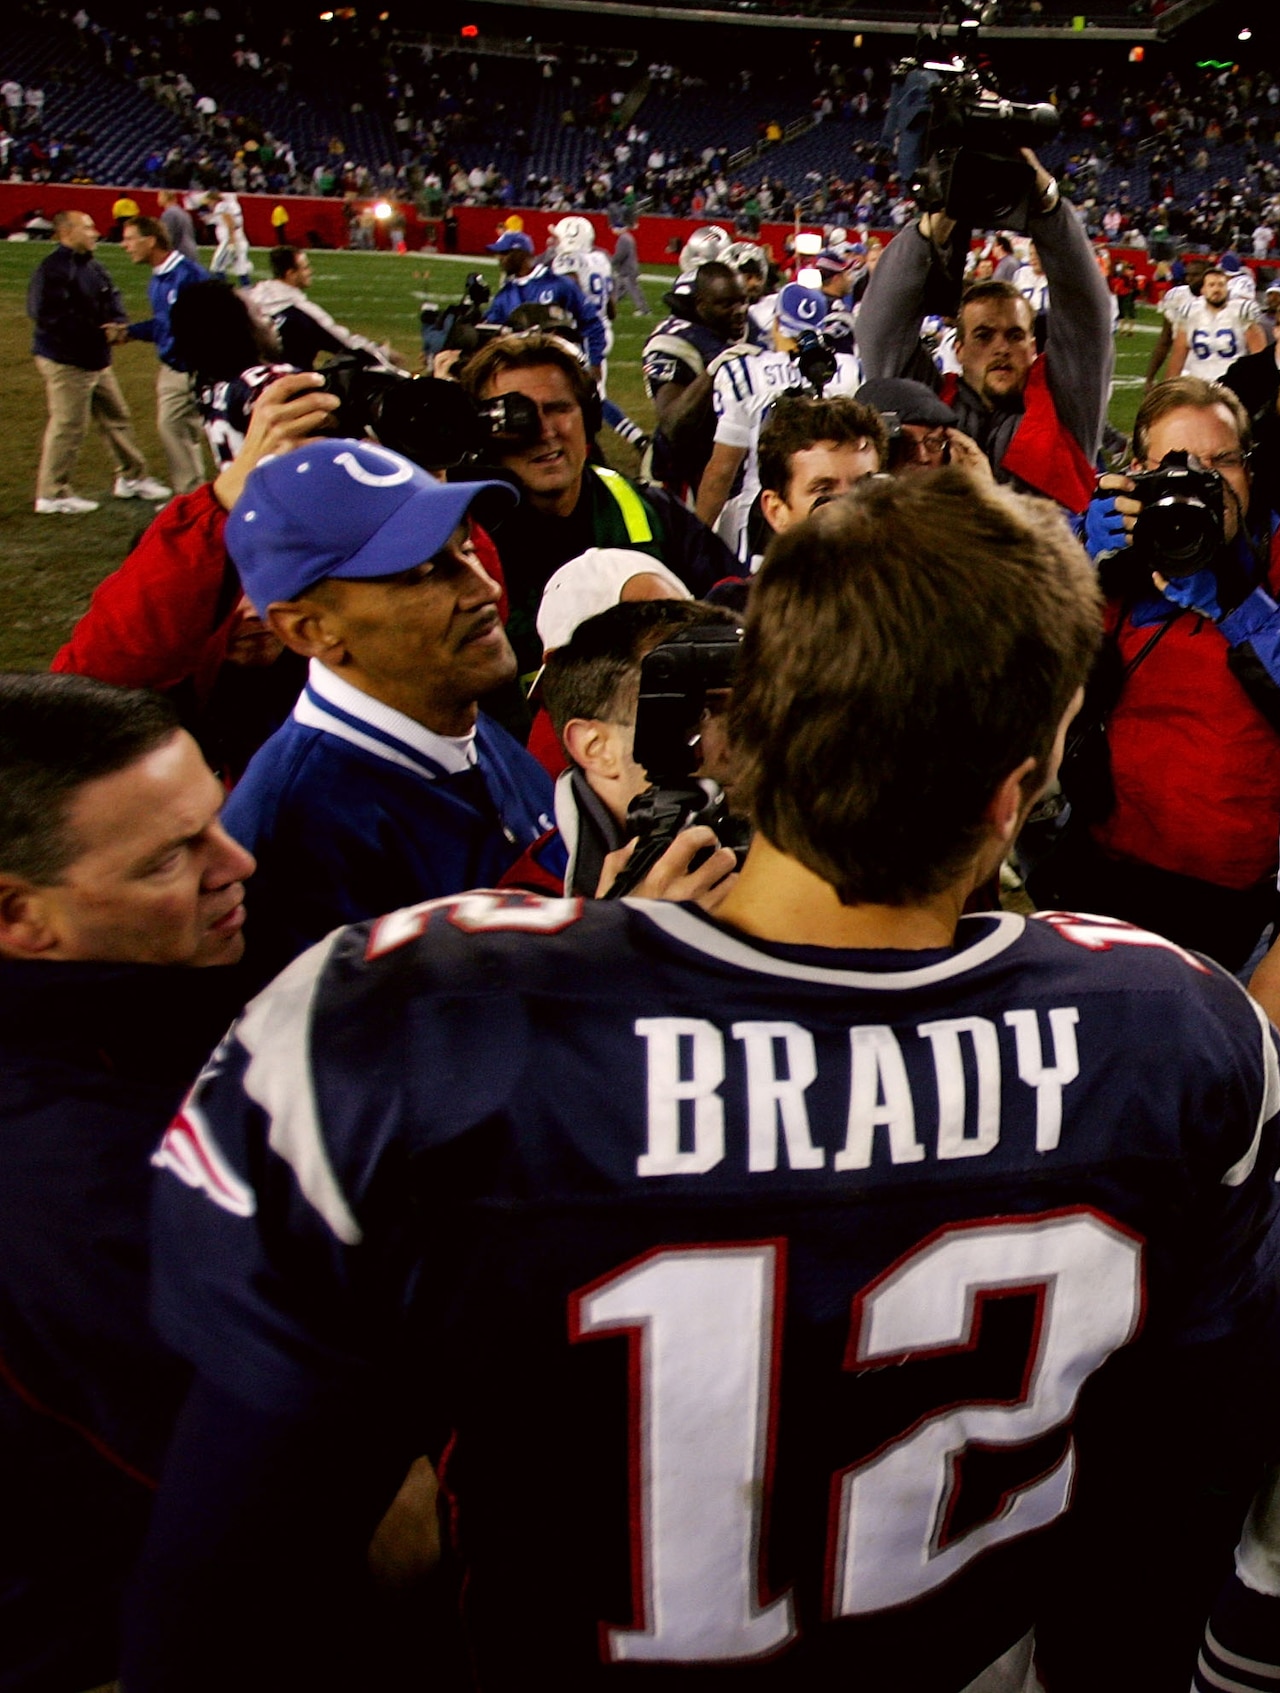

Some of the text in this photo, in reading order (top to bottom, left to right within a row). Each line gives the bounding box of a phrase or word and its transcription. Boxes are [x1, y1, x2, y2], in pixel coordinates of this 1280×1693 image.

[1191, 329, 1238, 360] 63
[634, 1006, 1081, 1178] BRADY
[568, 1204, 1144, 1665] 12
